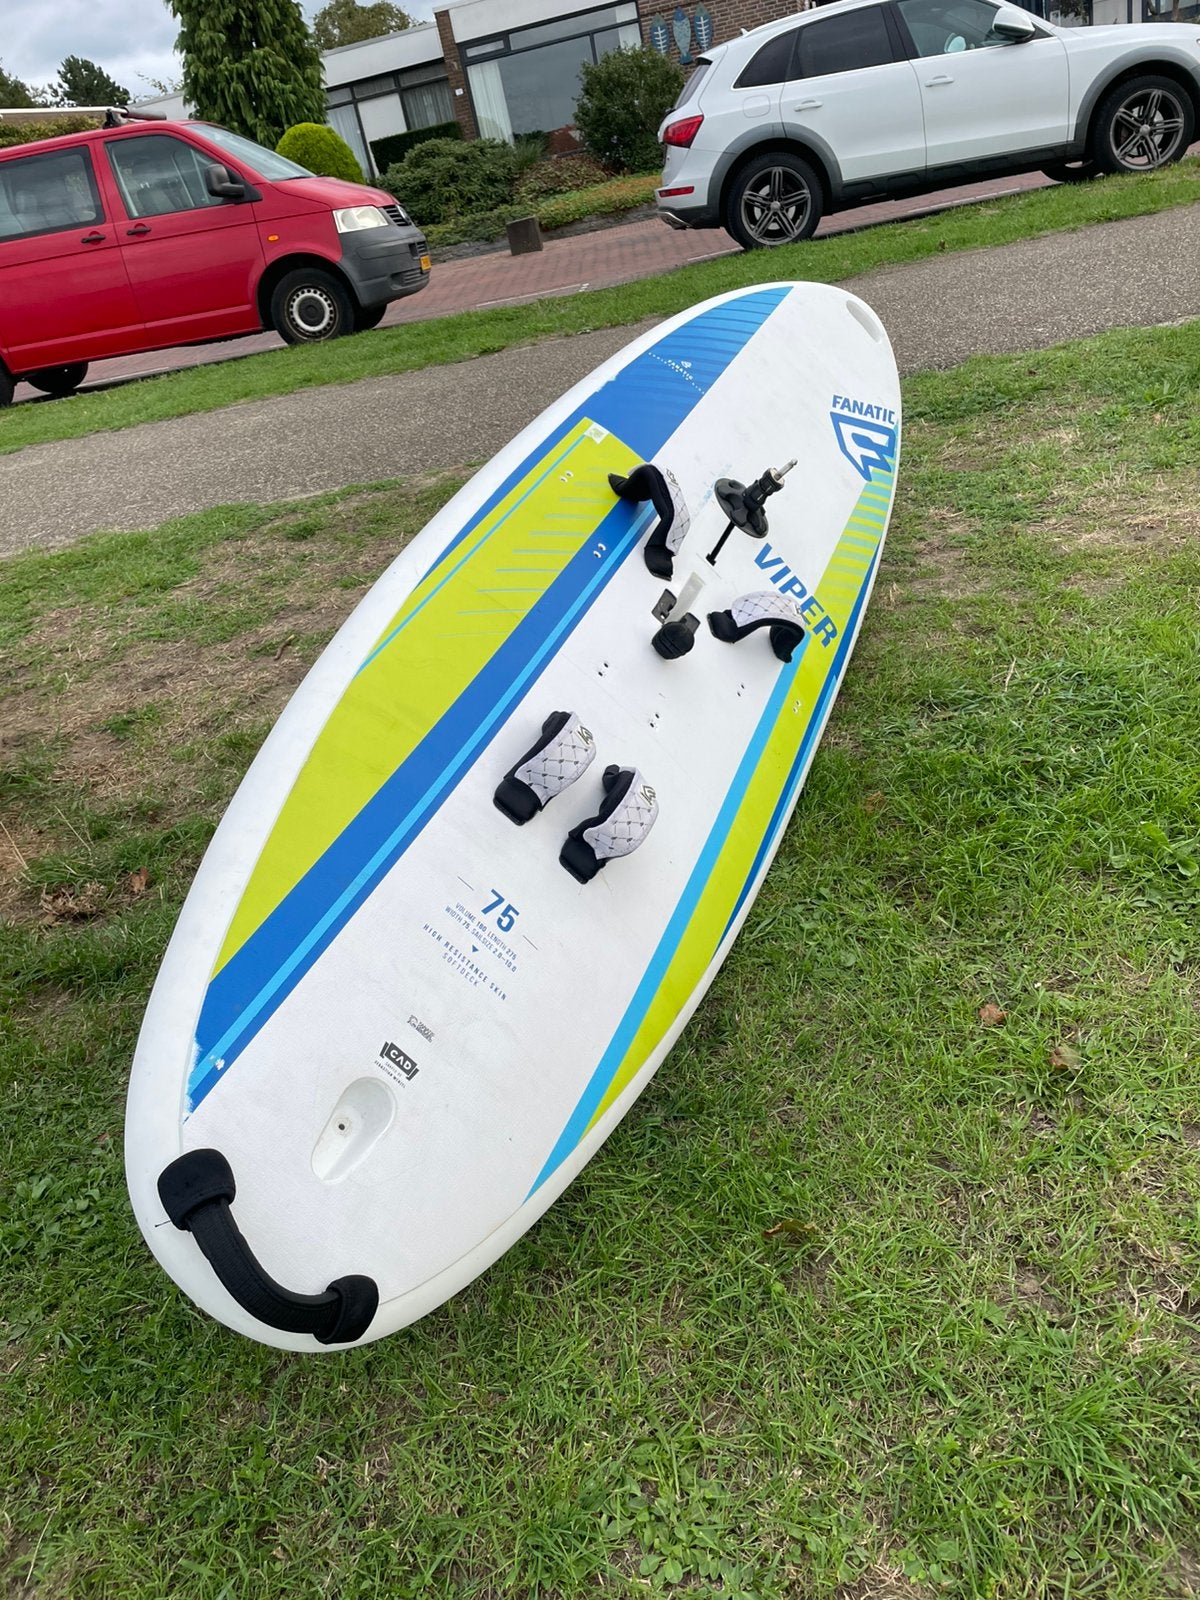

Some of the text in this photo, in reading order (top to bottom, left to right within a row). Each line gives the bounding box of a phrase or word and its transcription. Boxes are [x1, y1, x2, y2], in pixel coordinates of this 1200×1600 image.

[832, 394, 895, 425] FANATIC
[754, 542, 838, 648] VIPER
[444, 905, 462, 923] WIDTH
[455, 902, 476, 923] VOLUME
[487, 931, 507, 952] LENGTH
[481, 888, 520, 933] 75
[422, 923, 507, 1001] HIGH RESISTANCE SKIN
[442, 952, 479, 987] SOFTDECK
